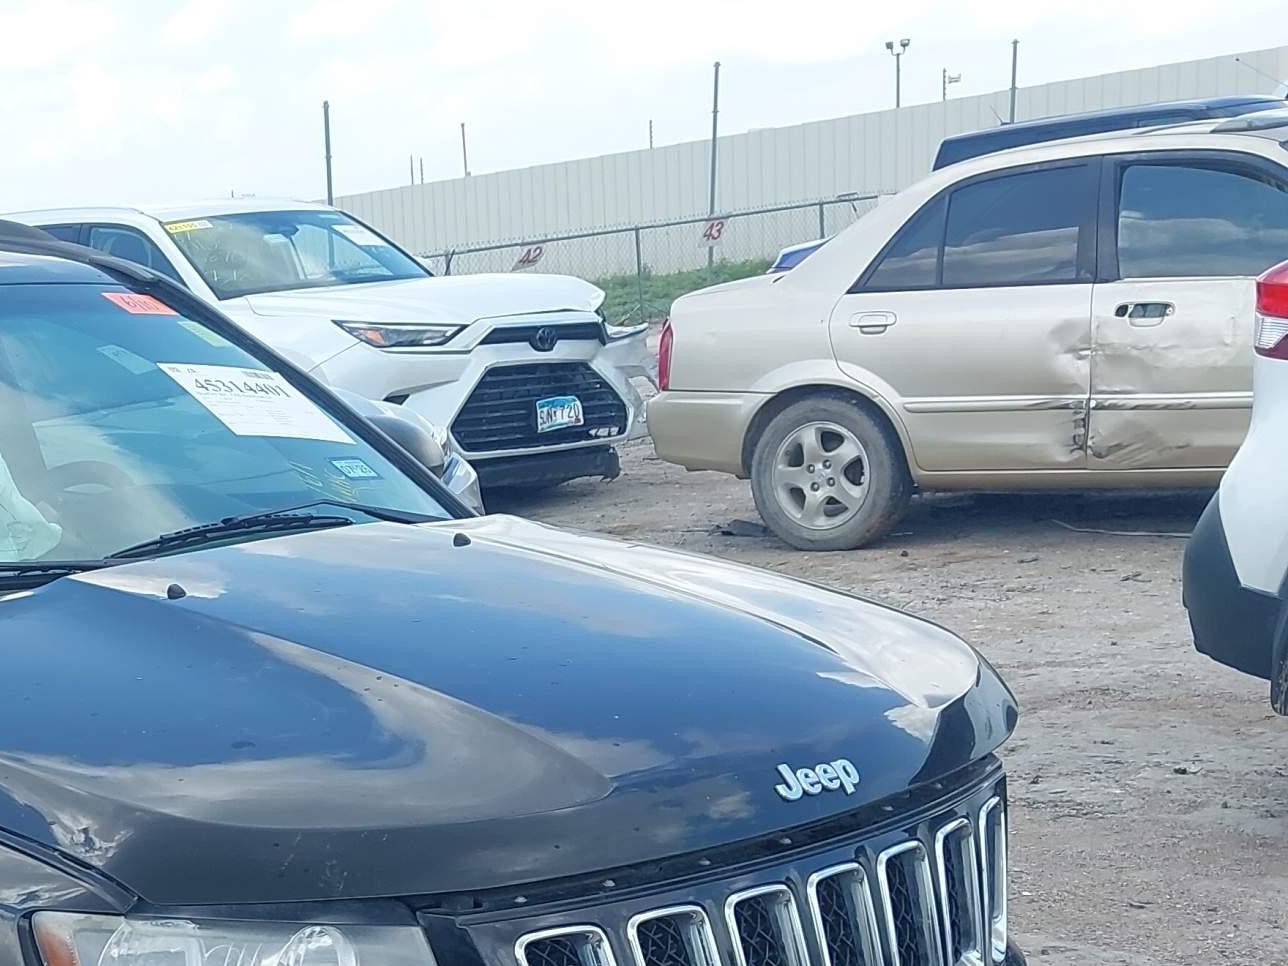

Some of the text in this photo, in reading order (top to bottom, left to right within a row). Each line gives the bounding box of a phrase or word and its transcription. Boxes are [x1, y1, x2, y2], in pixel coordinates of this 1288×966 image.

[703, 221, 724, 241] 43
[519, 246, 543, 265] 42
[194, 378, 291, 398] 45314401
[774, 759, 860, 801] Jeep
